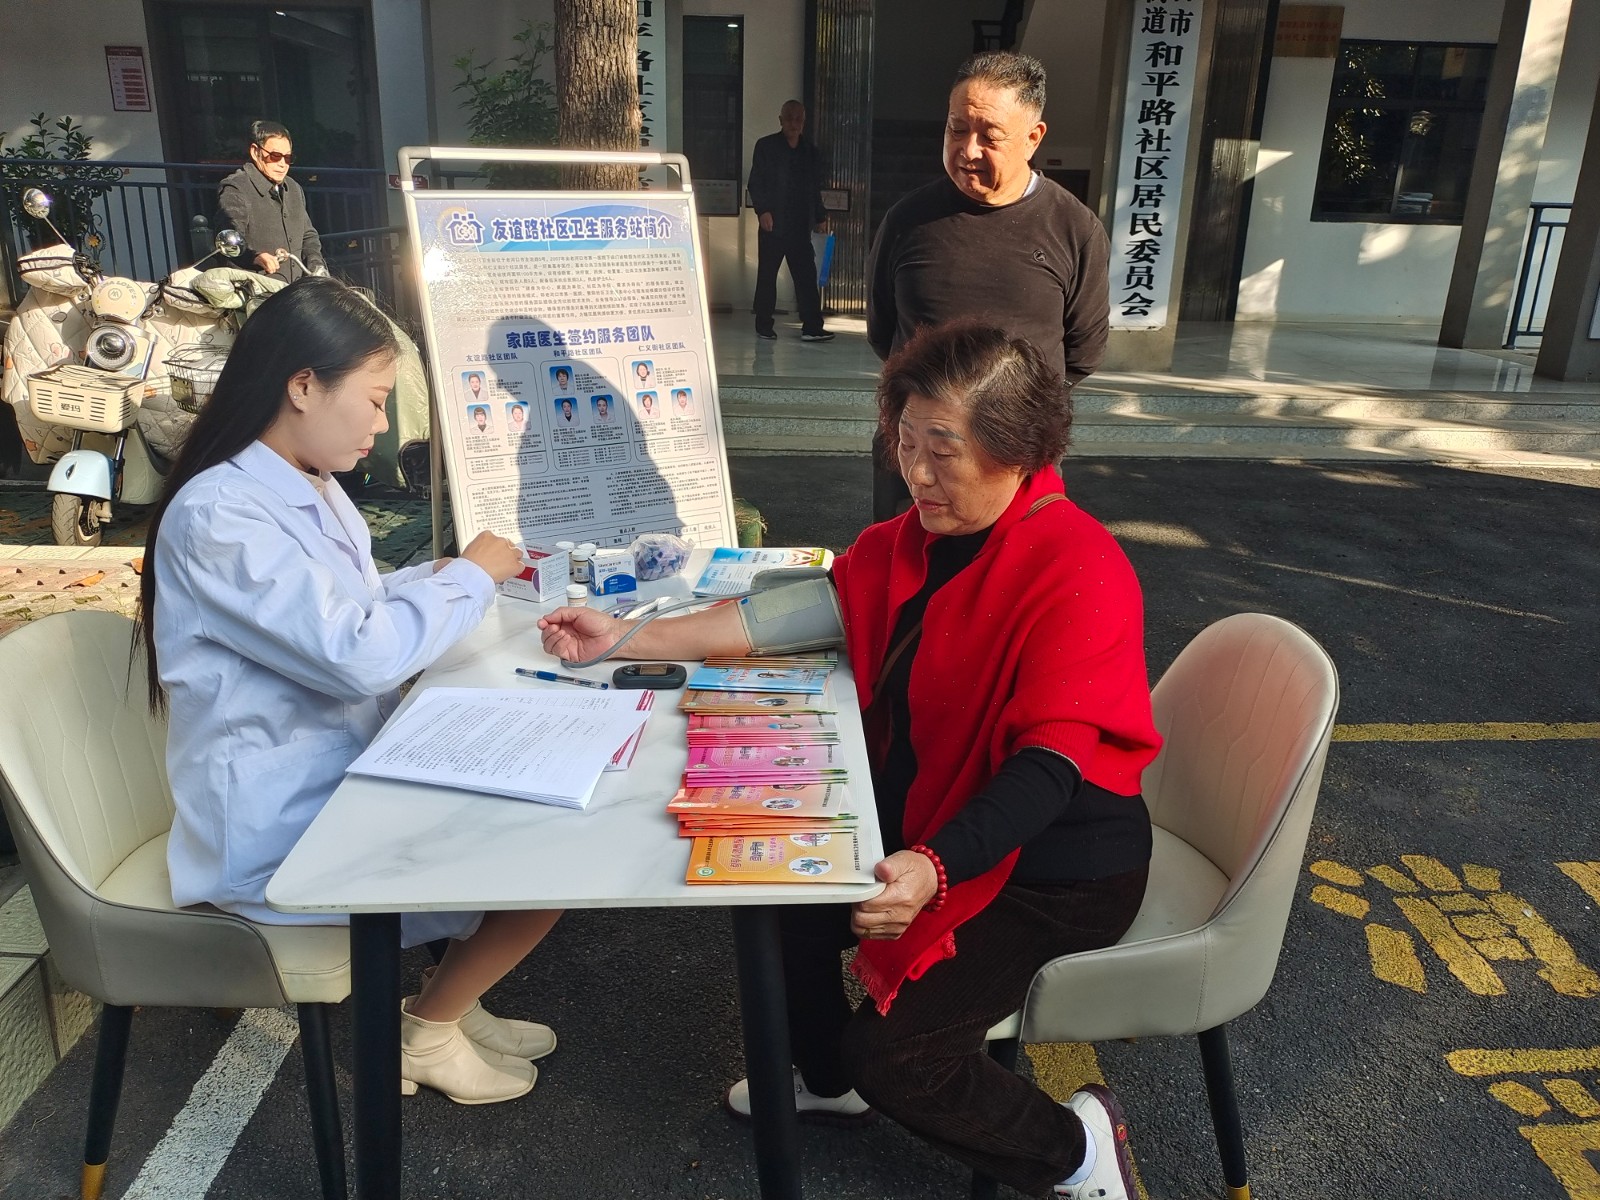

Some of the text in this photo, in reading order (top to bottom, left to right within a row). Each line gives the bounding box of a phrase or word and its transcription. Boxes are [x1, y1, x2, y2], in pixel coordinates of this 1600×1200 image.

[1141, 0, 1167, 34] 道
[1169, 0, 1194, 37] 市
[1119, 41, 1184, 317] 和平路社区居民委员会
[491, 216, 673, 241] 友谊路社区卫生服务站简介
[506, 326, 655, 349] 家庭医生签约服务团队
[638, 342, 686, 352] 仁义街社区团队
[466, 352, 518, 362] 友谊路社区团队
[553, 347, 603, 358] 和平路社区团队
[1309, 854, 1600, 998] 消
